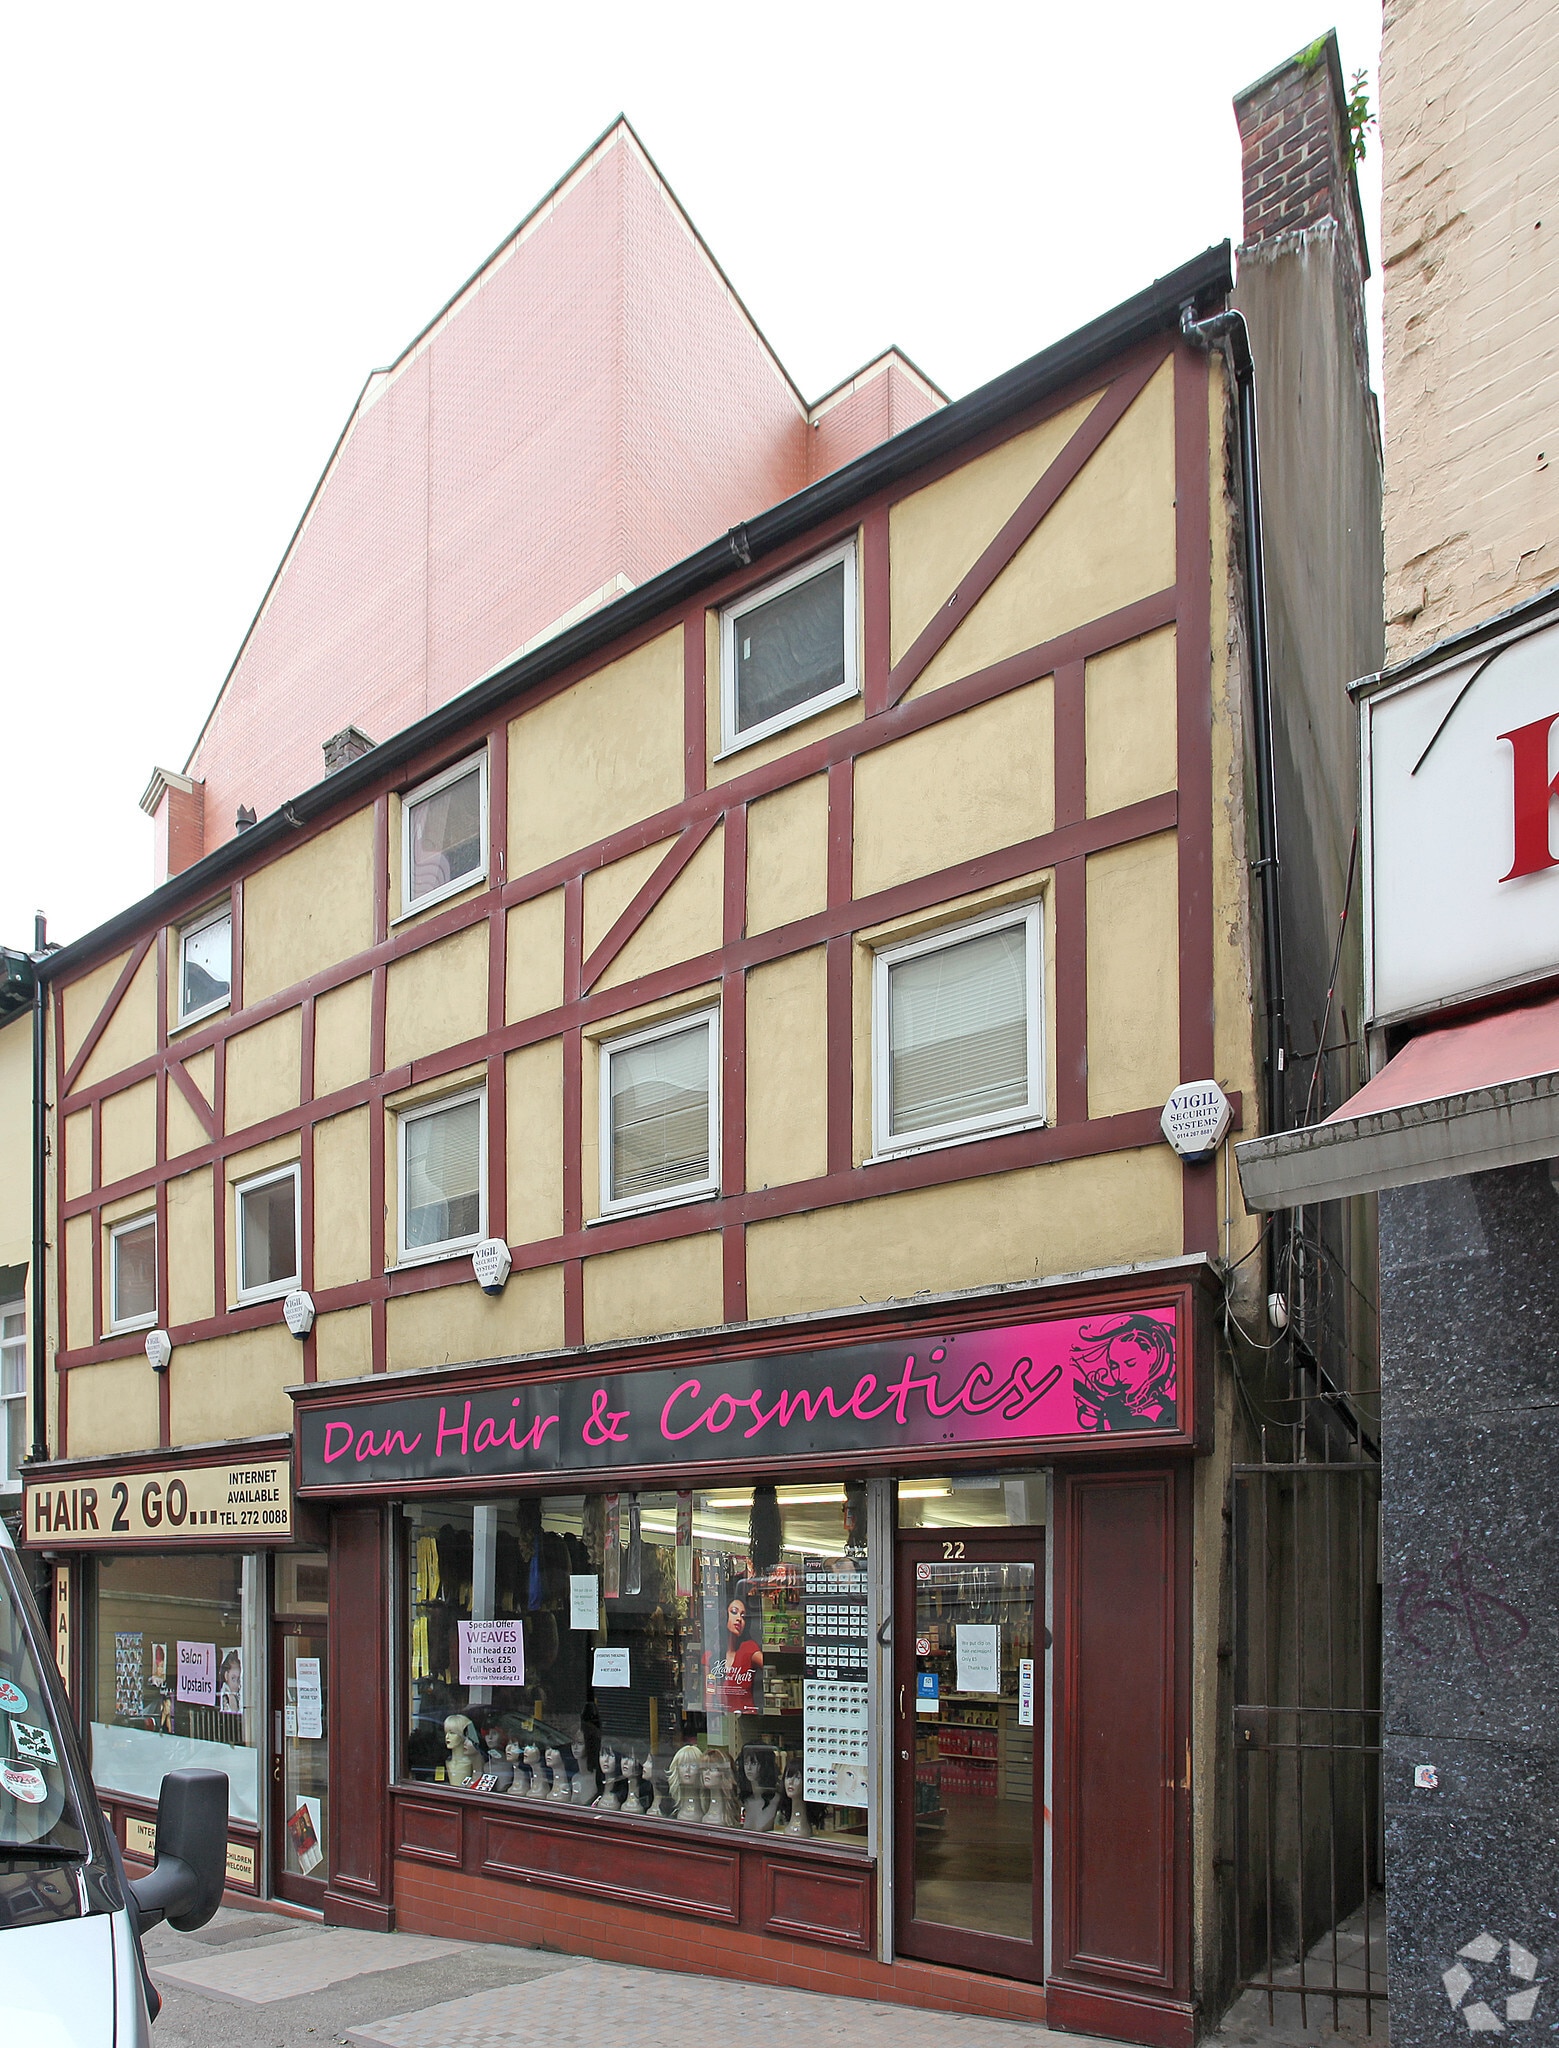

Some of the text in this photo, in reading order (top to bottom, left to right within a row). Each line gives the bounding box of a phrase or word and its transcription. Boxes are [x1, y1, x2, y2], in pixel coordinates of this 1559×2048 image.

[1171, 1092, 1219, 1110] VIGIL
[1170, 1107, 1220, 1122] SECURITY
[1172, 1117, 1218, 1132] SYSTEMS
[476, 1247, 498, 1258] VIGIL
[324, 1345, 1063, 1464] Dan Hair & Cosmetics
[229, 1469, 277, 1485] INTERNET
[227, 1488, 279, 1504] AVAILABLE
[35, 1487, 99, 1532] HAIR
[111, 1482, 130, 1531] 2
[220, 1509, 287, 1525] TEL 272 0088
[942, 1542, 965, 1559] 22
[469, 1620, 514, 1630] Special Offer
[467, 1631, 517, 1643] WEAVES
[181, 1648, 202, 1664] Salon
[467, 1646, 517, 1654] half head £20
[473, 1656, 512, 1664] tracks £25
[470, 1665, 517, 1673] full head £30
[181, 1675, 212, 1694] Upstairs
[137, 1824, 155, 1836] INTER
[226, 1851, 252, 1864] CHILDREN
[226, 1862, 251, 1874] WELCOME
